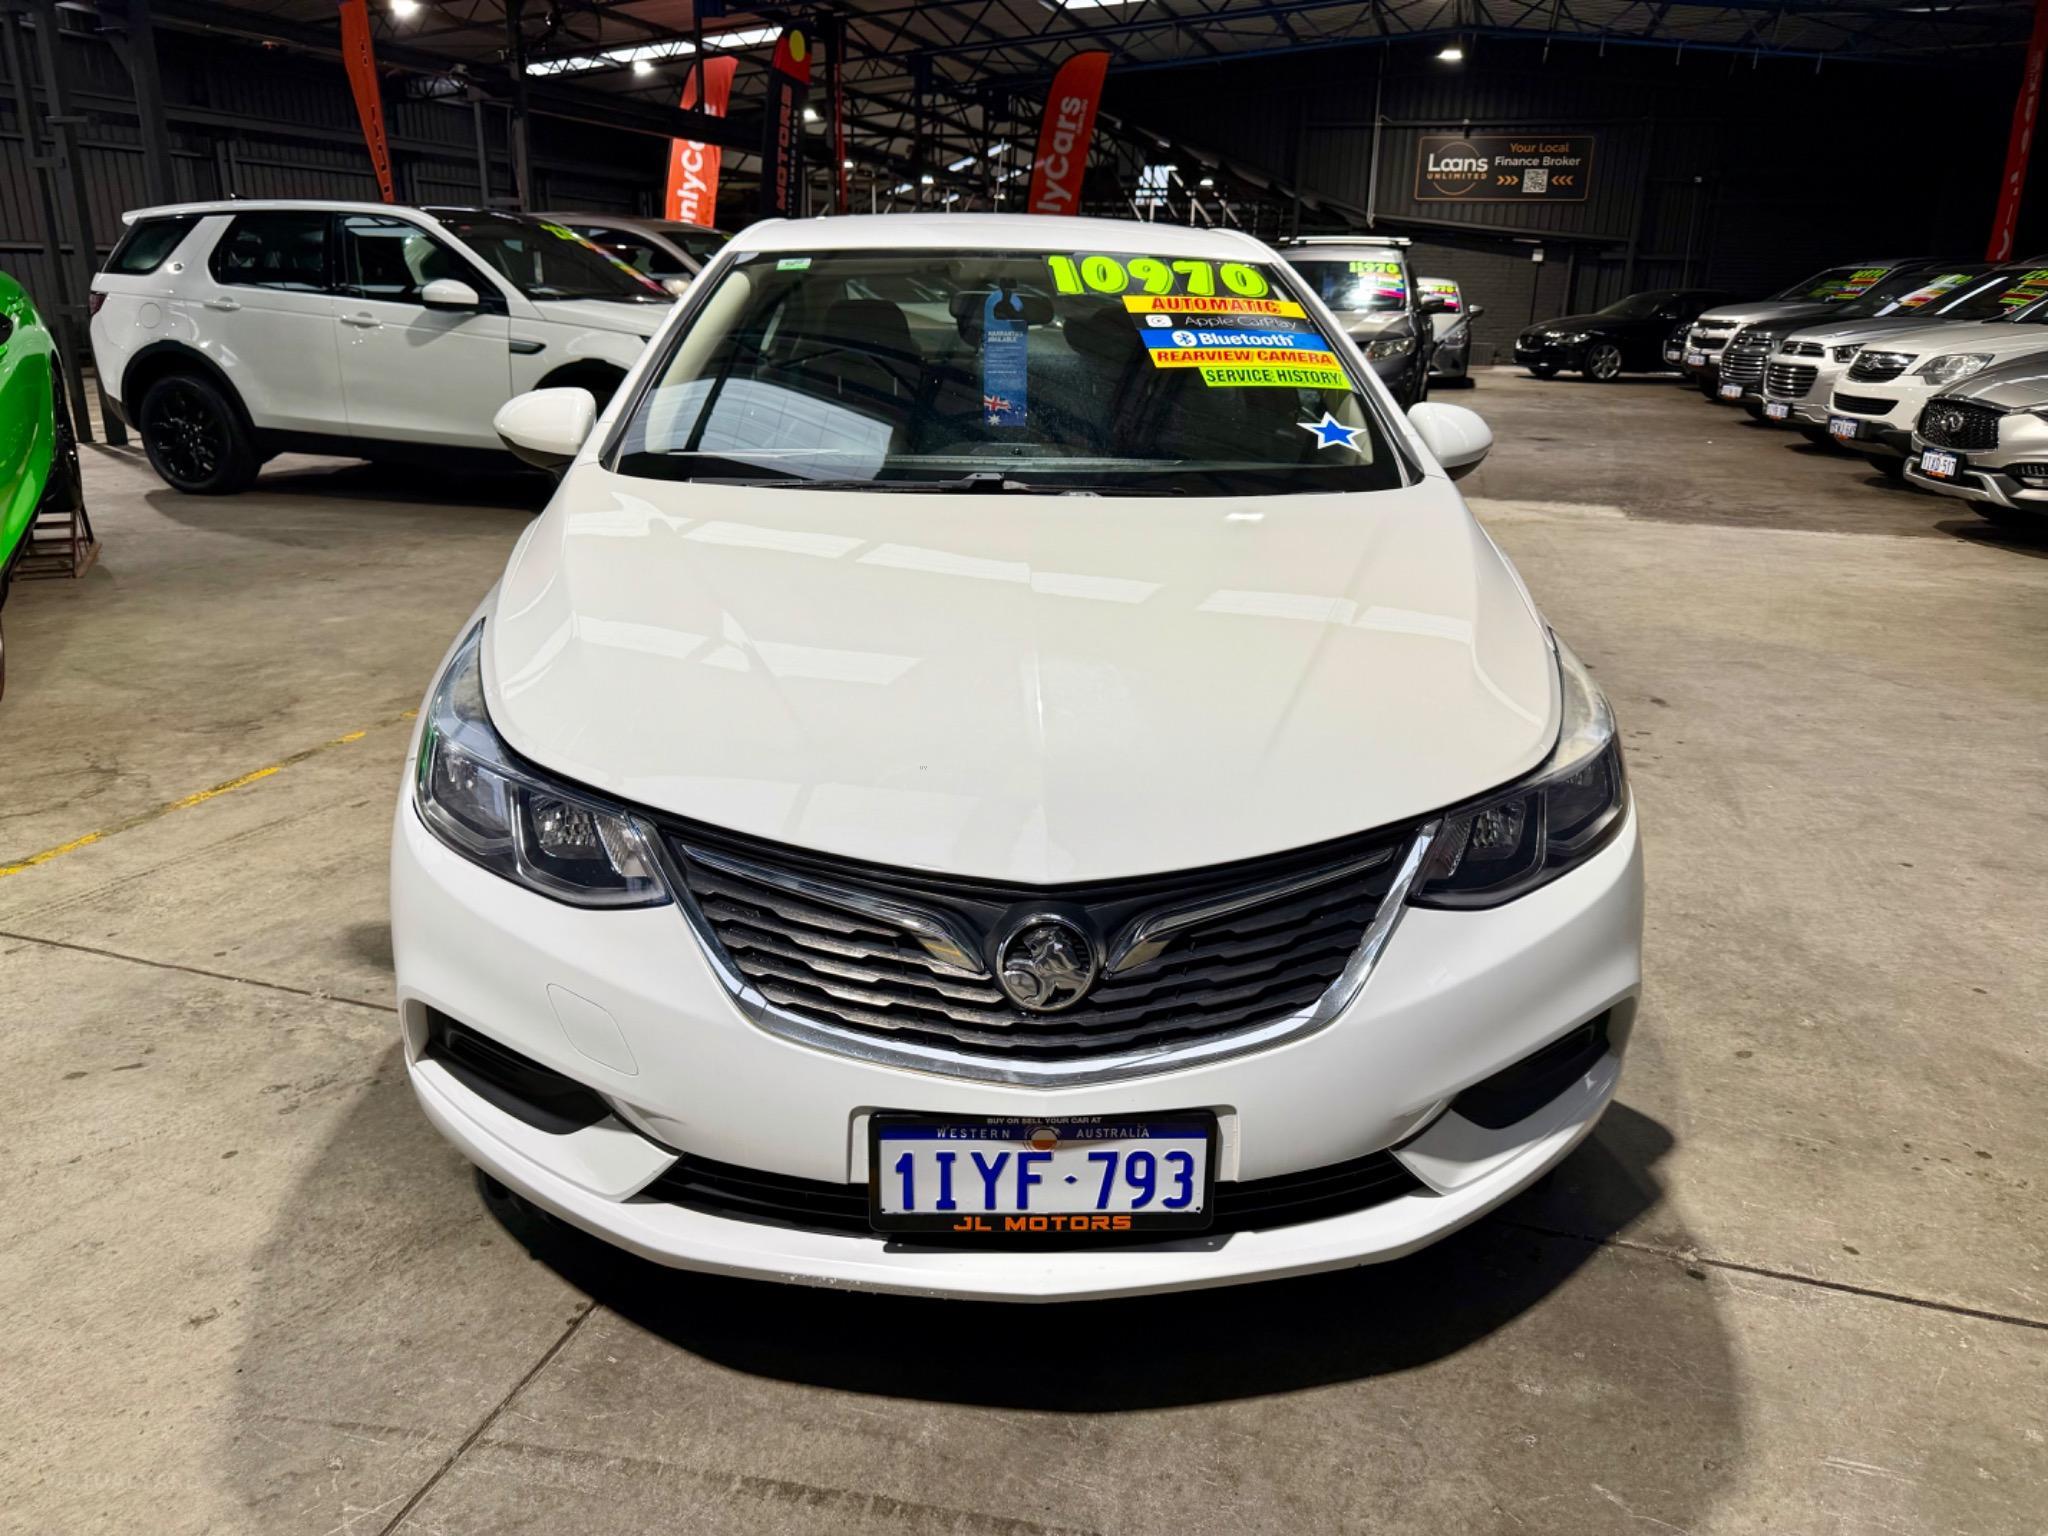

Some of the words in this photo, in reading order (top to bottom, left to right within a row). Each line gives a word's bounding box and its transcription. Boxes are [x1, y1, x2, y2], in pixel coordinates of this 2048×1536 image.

[776, 84, 792, 209] MOTORS
[1510, 143, 1537, 153] Your
[1539, 143, 1570, 153] Local
[1428, 153, 1489, 172] Loans
[1494, 155, 1540, 166] Finance
[1543, 156, 1581, 166] Broker
[1047, 256, 1269, 297] 10970
[1151, 296, 1281, 313] AUTOMATIC
[1184, 315, 1234, 329] Apple
[1237, 315, 1298, 330] CarPlay
[1157, 350, 1250, 363] REARVIEW
[1256, 351, 1333, 365] CAMERA
[1206, 369, 1273, 383] SERVICE
[1276, 370, 1341, 385] HISTORY
[936, 1128, 1011, 1139] WESTERN
[1076, 1127, 1151, 1138] AUSTRALIA
[953, 1216, 992, 1231] JL
[1005, 1215, 1132, 1231] MOTORS
